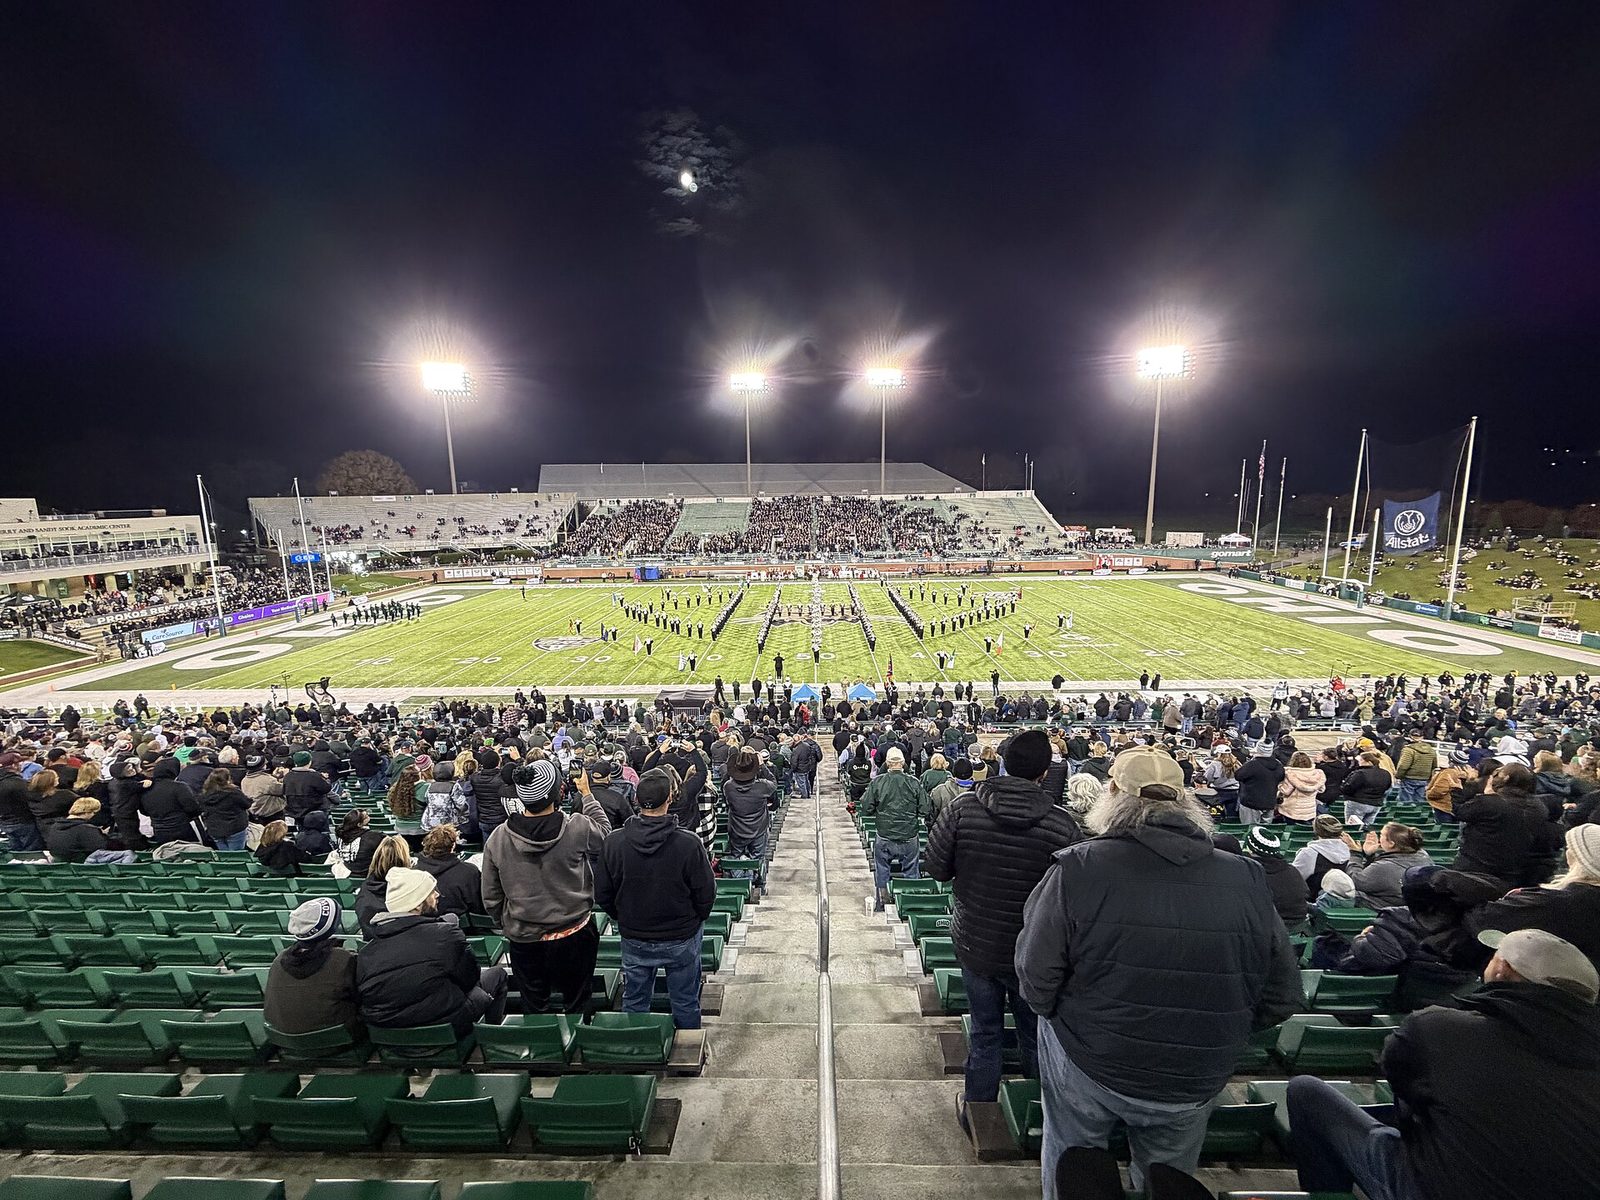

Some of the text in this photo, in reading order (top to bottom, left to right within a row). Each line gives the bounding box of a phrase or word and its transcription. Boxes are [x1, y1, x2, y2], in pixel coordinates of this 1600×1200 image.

[1210, 549, 1252, 558] gomart
[97, 608, 148, 625] PROKOS
[237, 612, 255, 621] Choice
[43, 633, 76, 646] BOBCATS
[151, 630, 184, 641] CareSource
[795, 652, 836, 660] 50
[935, 918, 951, 928] OHIO
